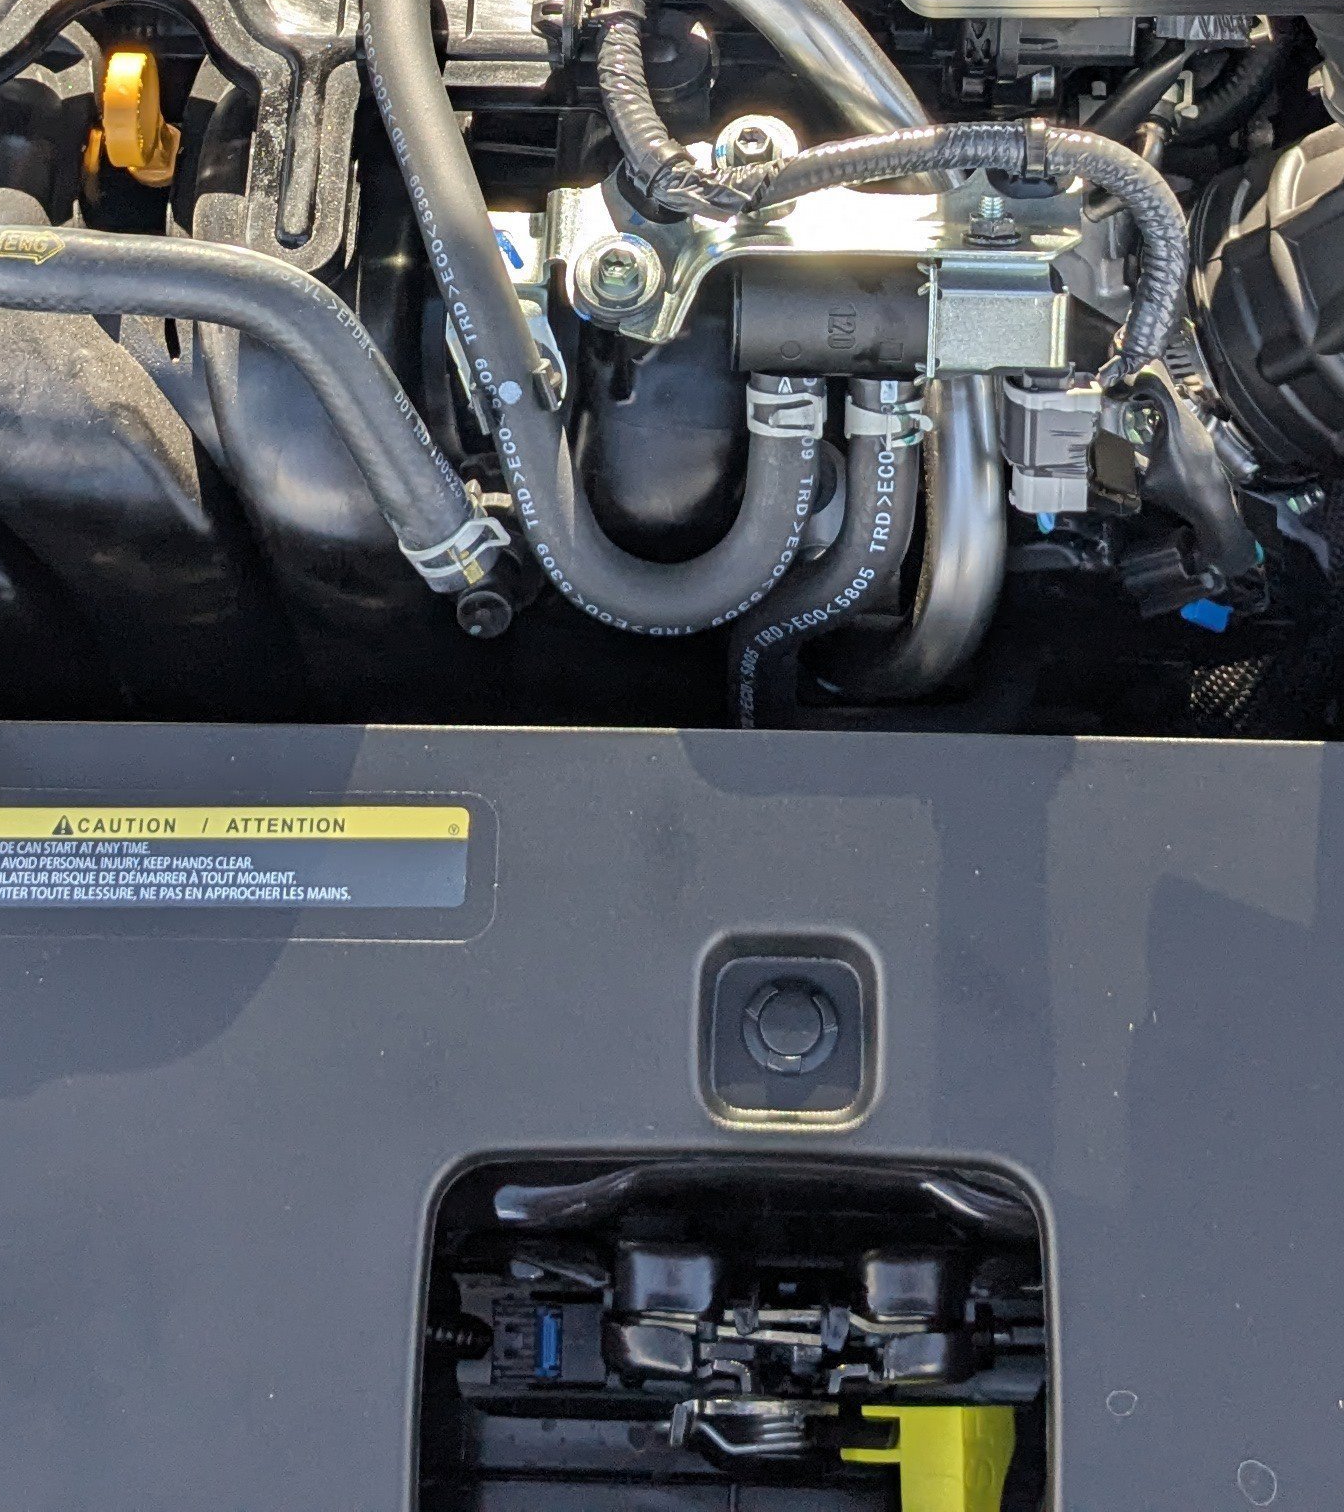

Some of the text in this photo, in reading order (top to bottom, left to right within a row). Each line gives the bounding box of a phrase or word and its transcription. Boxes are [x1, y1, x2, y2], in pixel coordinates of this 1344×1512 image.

[2, 233, 50, 254] ENG
[78, 818, 346, 833] CAUTION / ATTENTION
[16, 841, 41, 854] CAN
[43, 841, 78, 854] START
[80, 841, 94, 854] AT
[96, 841, 120, 854] ANY
[122, 841, 151, 854] TIME.
[1, 857, 37, 869] AVOID
[39, 857, 98, 869] PERSONAL
[100, 857, 141, 871] INJURY,
[143, 857, 171, 869] KEEP
[173, 857, 213, 869] HANDS
[215, 857, 254, 869] CLEAR.
[51, 871, 95, 885] RISQUE
[99, 871, 116, 885] DE
[118, 869, 187, 885] DÉMARRER
[188, 868, 199, 885] À
[201, 871, 235, 885] TOUT
[236, 871, 297, 885] MOMENT.
[30, 887, 71, 900] TOUTE
[73, 886, 138, 901] BLESSURE,
[140, 887, 157, 900] NE
[159, 887, 183, 900] PAS
[184, 887, 203, 900] EN
[205, 887, 280, 900] APPROCHER
[282, 887, 304, 900] LES
[306, 887, 352, 900] MAINS.
